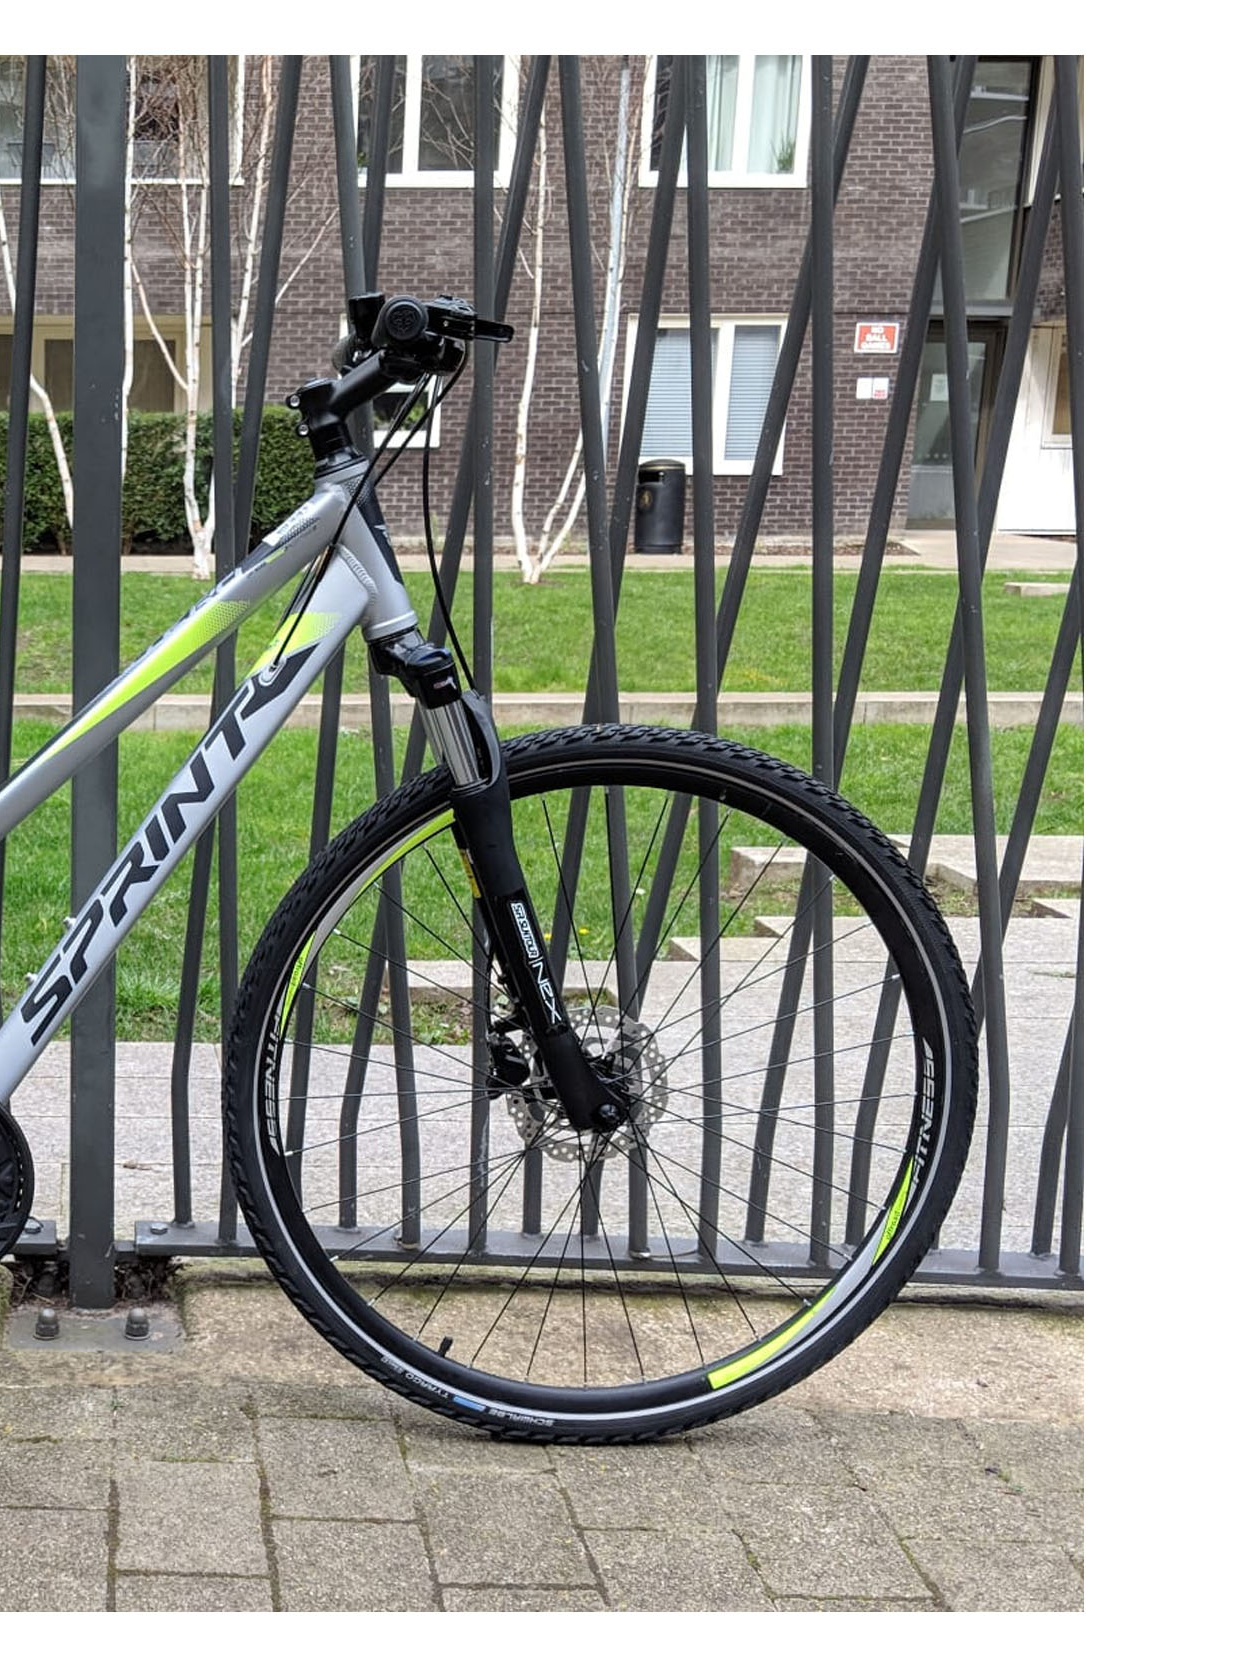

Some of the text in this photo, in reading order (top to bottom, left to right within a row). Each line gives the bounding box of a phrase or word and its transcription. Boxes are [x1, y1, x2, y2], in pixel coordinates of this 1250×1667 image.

[20, 680, 253, 1047] SPRINT
[264, 1013, 281, 1139] FITNESS
[913, 1057, 935, 1184] FITNESS
[488, 1407, 555, 1427] SCHWALBE
